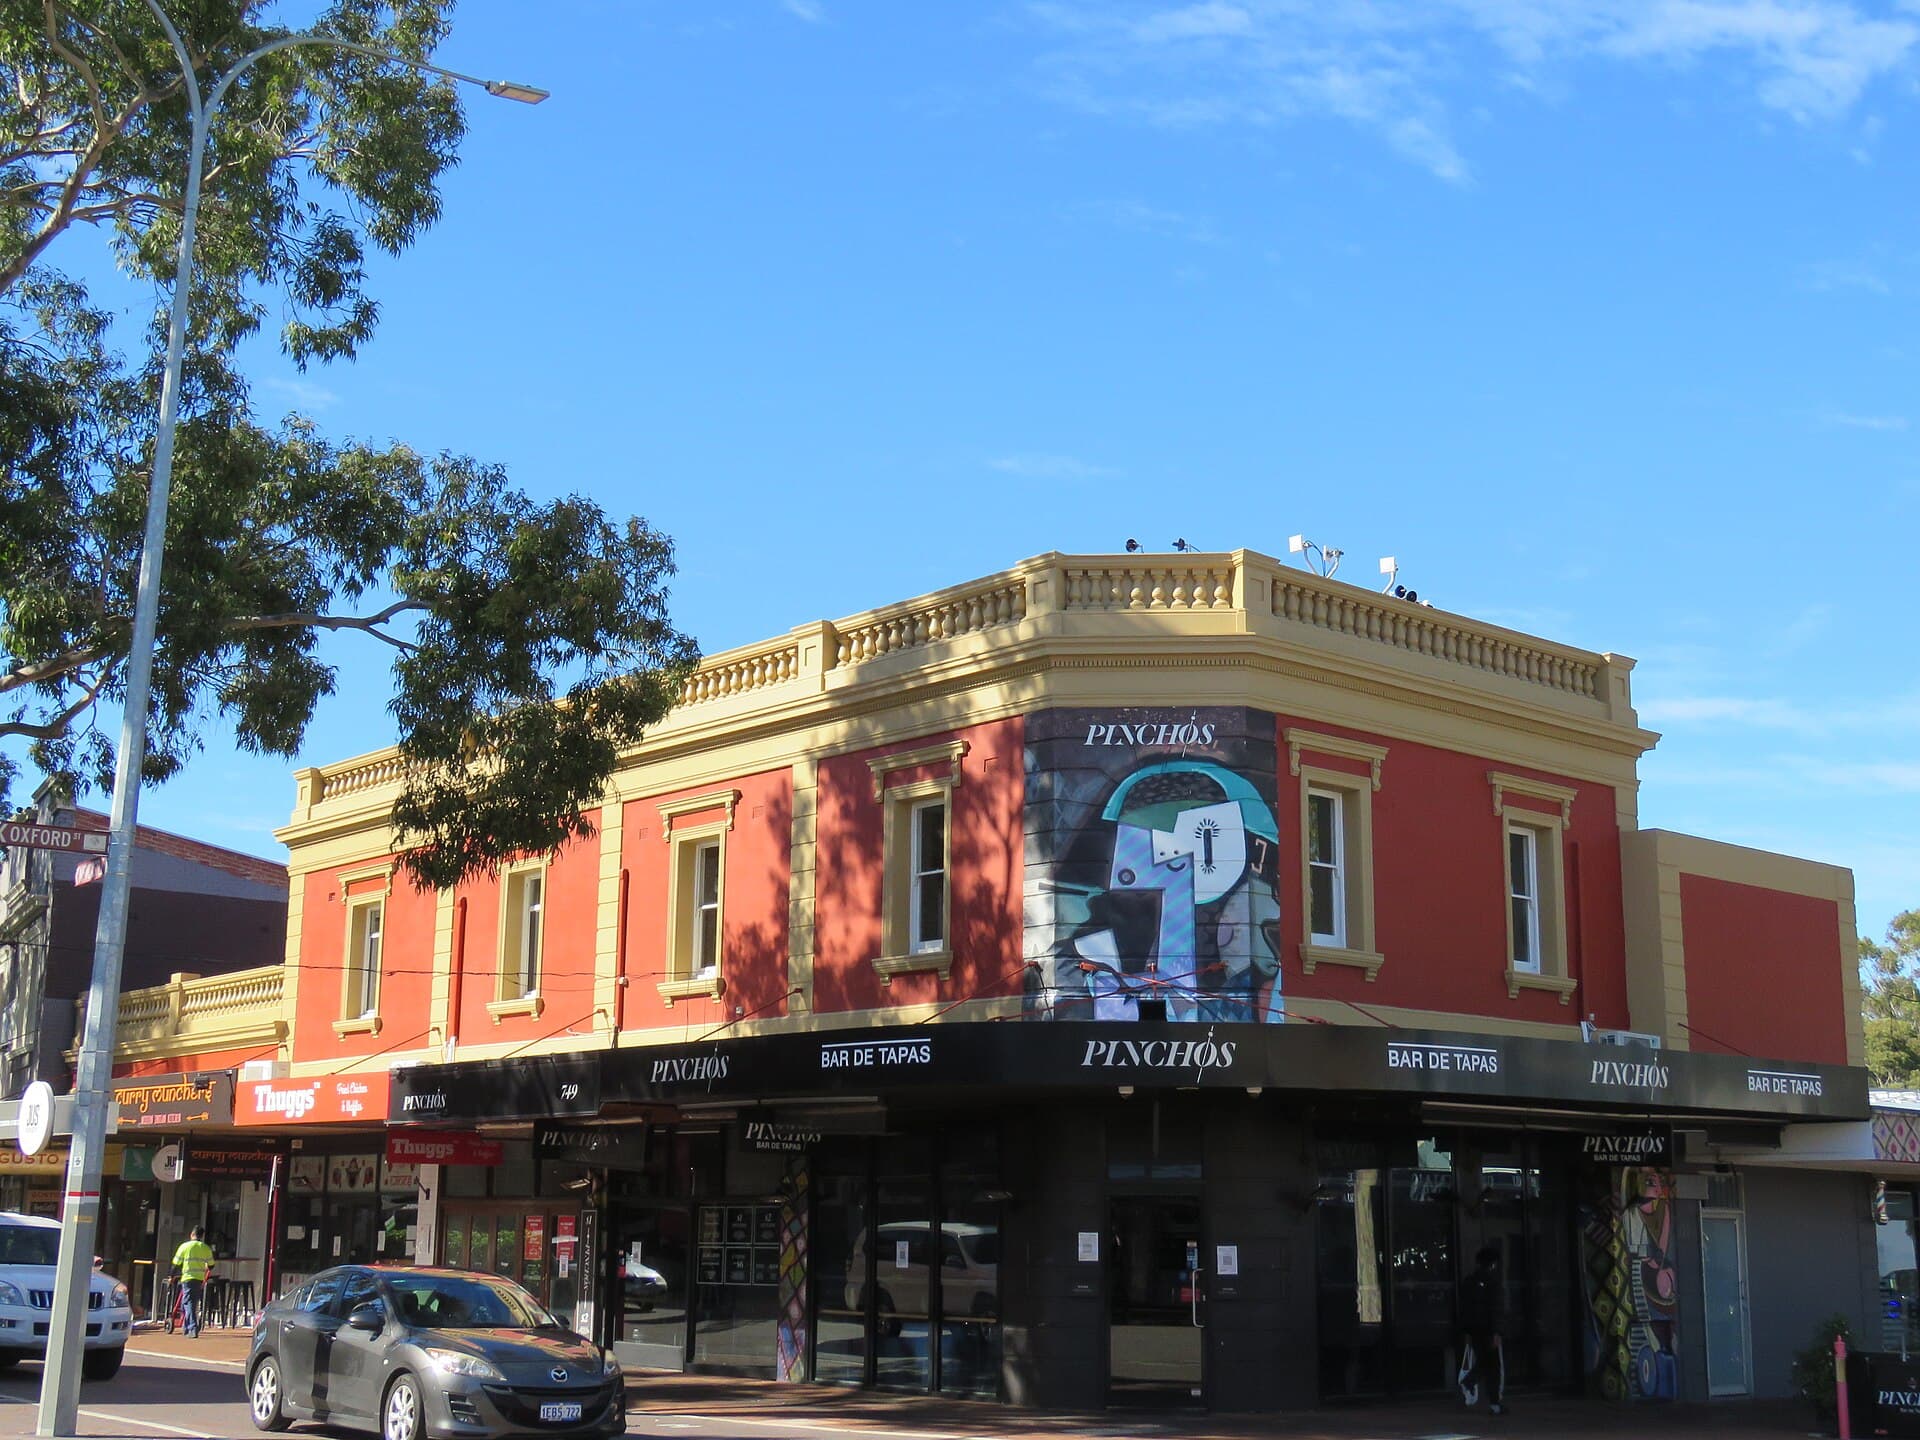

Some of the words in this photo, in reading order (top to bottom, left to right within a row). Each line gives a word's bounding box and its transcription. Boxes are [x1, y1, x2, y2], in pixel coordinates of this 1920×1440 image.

[1083, 716, 1215, 746] PINCHOS
[10, 826, 71, 847] OXFORD
[73, 832, 81, 840] ST
[821, 1051, 849, 1068] BAR
[854, 1048, 873, 1066] DE
[878, 1045, 931, 1064] TAPAS
[1081, 1031, 1236, 1068] PINCHOS
[1388, 1049, 1423, 1069] BAR
[1428, 1051, 1450, 1070] DE
[1453, 1053, 1497, 1073] TAPAS
[650, 1048, 729, 1083] PINCHOS
[1590, 1056, 1669, 1088] PINCHOS
[561, 1083, 579, 1100] 749
[1747, 1076, 1770, 1093] BAR
[1772, 1078, 1787, 1094] DE
[1789, 1080, 1822, 1096] TAPAS
[254, 1084, 315, 1118] Thuggs
[403, 1088, 447, 1111] PINCHOS
[26, 1104, 40, 1126] JUS
[392, 1138, 455, 1159] Thuggs
[1583, 1130, 1665, 1153] PINCHOS
